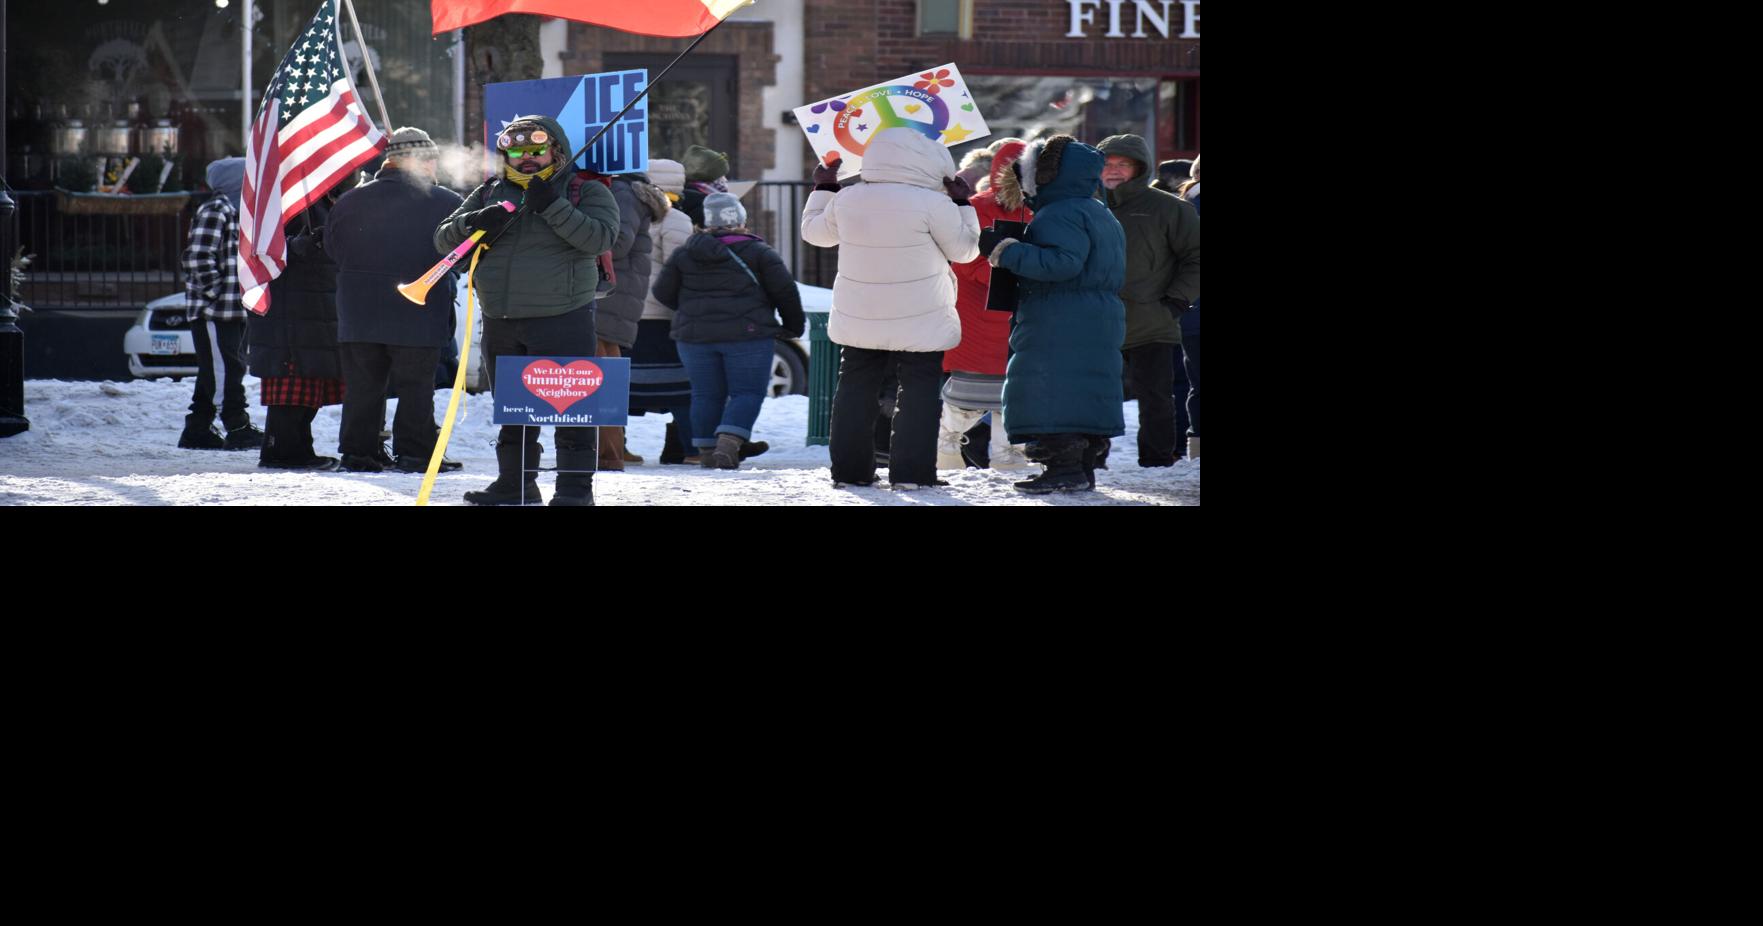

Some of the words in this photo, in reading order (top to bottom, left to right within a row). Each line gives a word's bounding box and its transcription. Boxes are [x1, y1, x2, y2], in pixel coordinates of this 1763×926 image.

[584, 72, 645, 124] ICE
[838, 104, 857, 129] PEACE
[866, 89, 892, 101] LOVE
[904, 89, 935, 103] HOPE
[584, 121, 645, 171] OUT
[533, 367, 547, 375] We
[549, 367, 574, 375] LOVE
[576, 368, 593, 376] our
[523, 374, 602, 388] Immigrant
[536, 388, 588, 398] Neighbors
[503, 405, 524, 413] here
[525, 405, 534, 413] in
[528, 414, 593, 423] Northfield!
